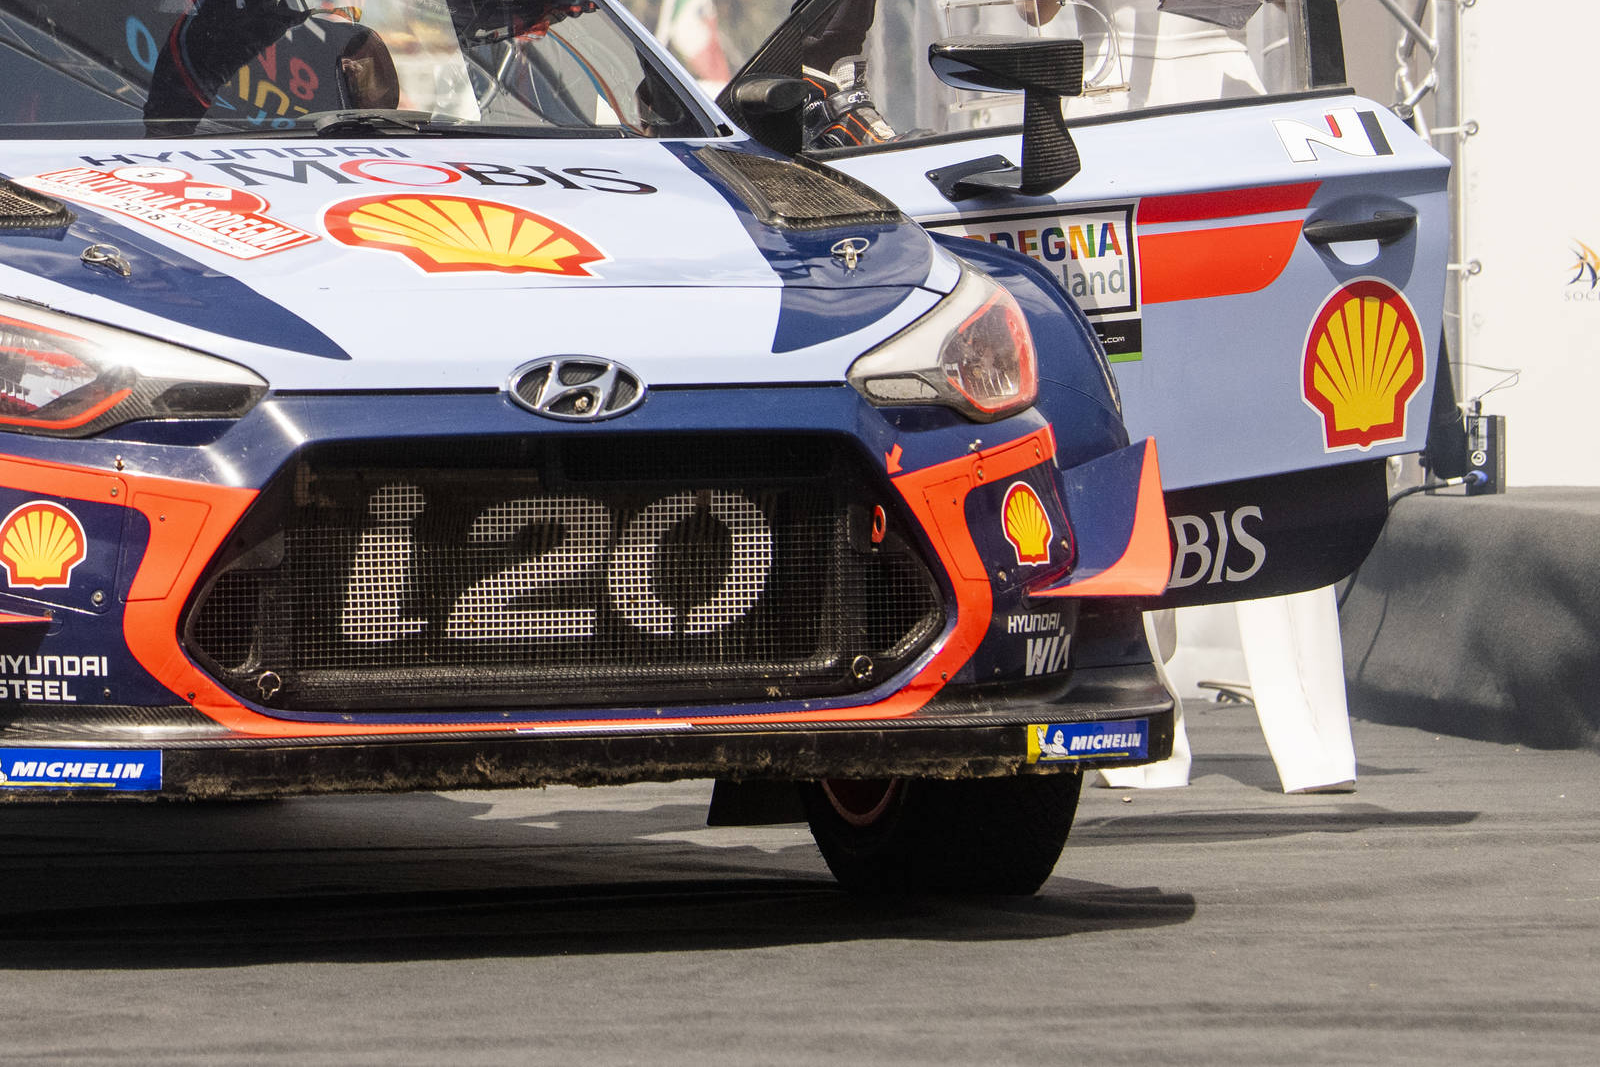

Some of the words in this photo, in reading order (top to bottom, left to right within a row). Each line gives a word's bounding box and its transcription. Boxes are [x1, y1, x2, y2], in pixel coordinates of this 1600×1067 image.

[79, 145, 412, 166] HYUNDAI
[209, 159, 658, 194] MOBIS
[42, 169, 116, 192] RALLY
[103, 181, 183, 209] ITALIA
[170, 202, 301, 250] SARDEGNA
[114, 203, 166, 221] 2018
[1060, 259, 1126, 298] land
[1167, 505, 1267, 590] BIS
[1007, 612, 1060, 634] HYUNDAI
[1070, 732, 1142, 752] MICHELIN
[10, 761, 145, 779] MICHELIN
